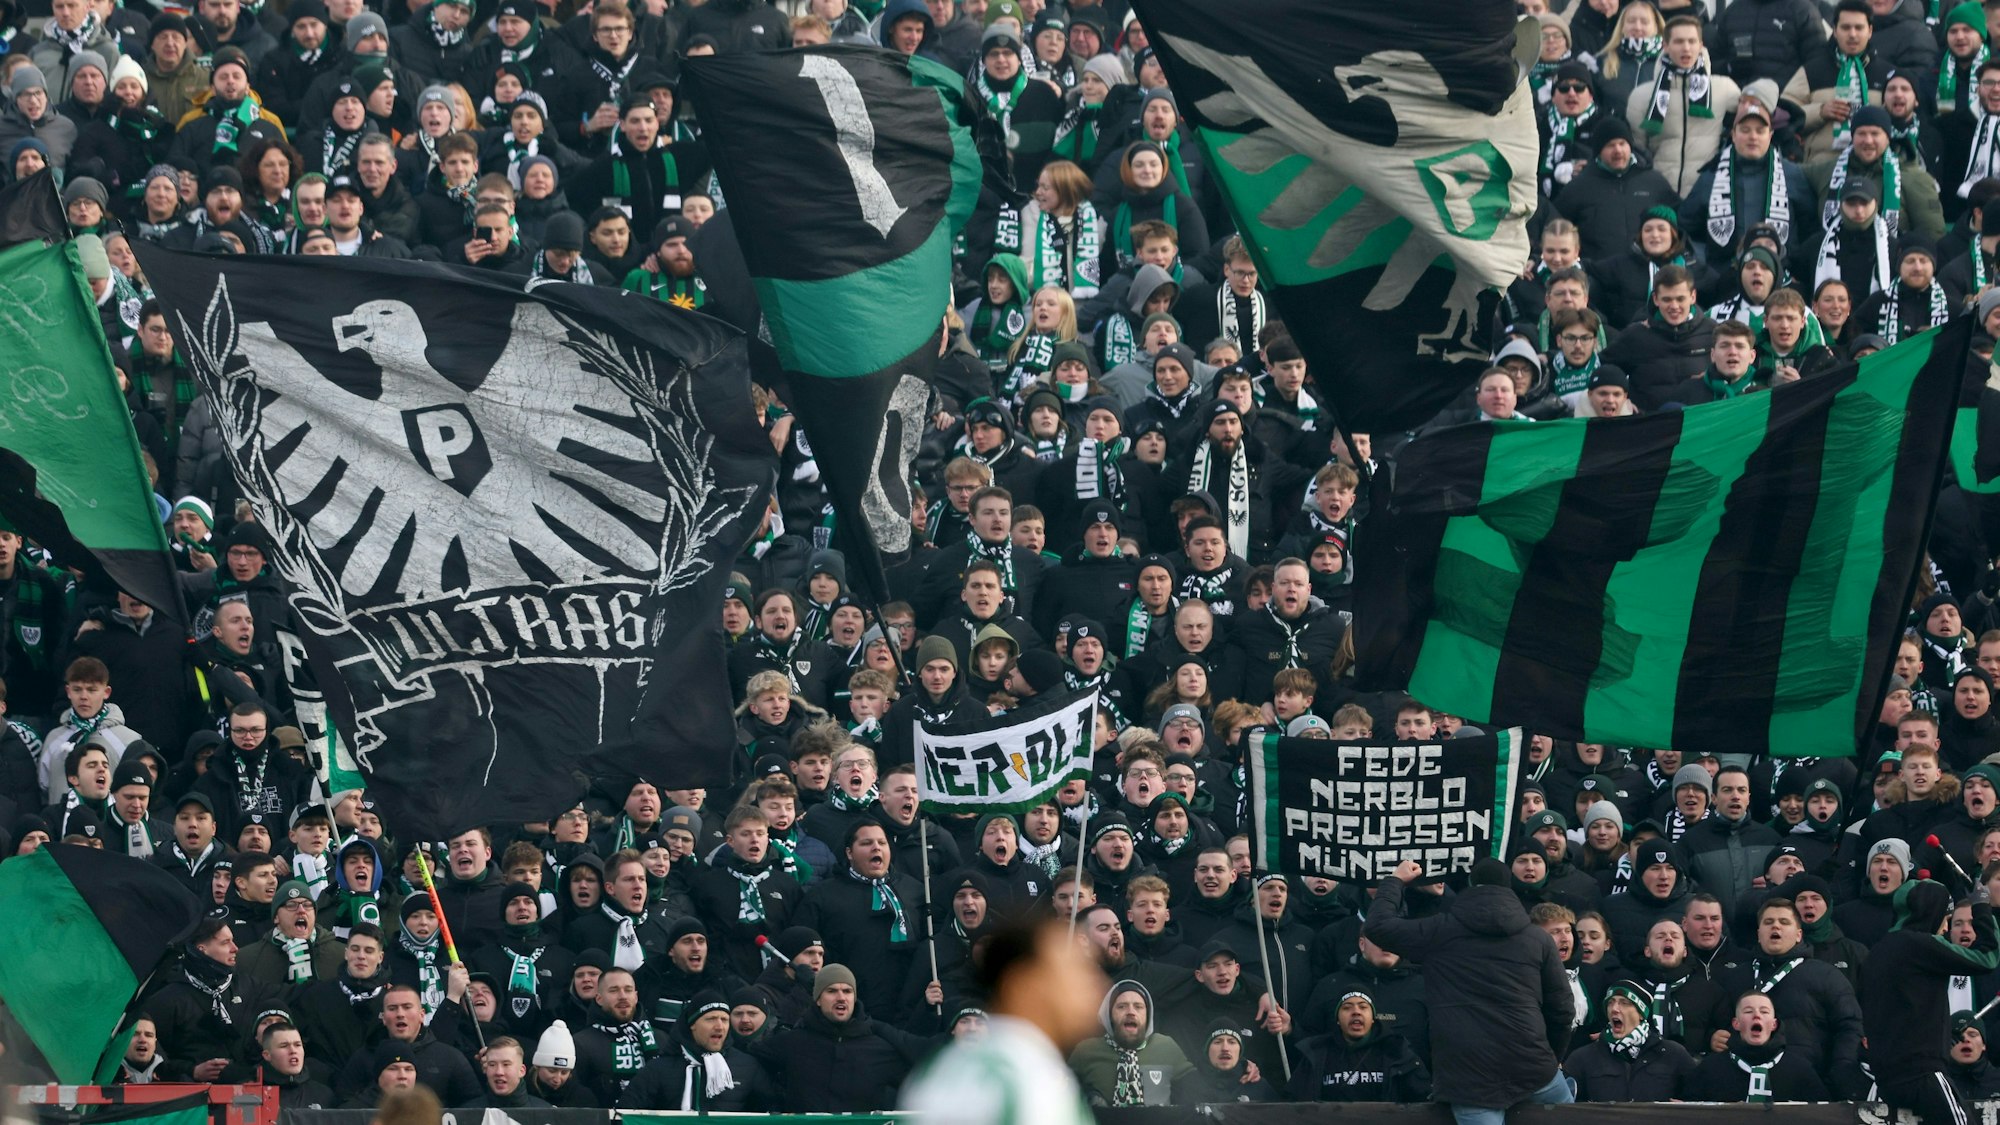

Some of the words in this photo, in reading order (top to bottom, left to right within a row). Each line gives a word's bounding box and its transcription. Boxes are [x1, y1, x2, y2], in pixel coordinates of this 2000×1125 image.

[417, 403, 474, 481] P
[386, 590, 648, 662] ULTRAS
[1337, 745, 1443, 778] FEDE
[1310, 777, 1467, 812] NERBLO
[1284, 808, 1491, 846] PREUSSEN
